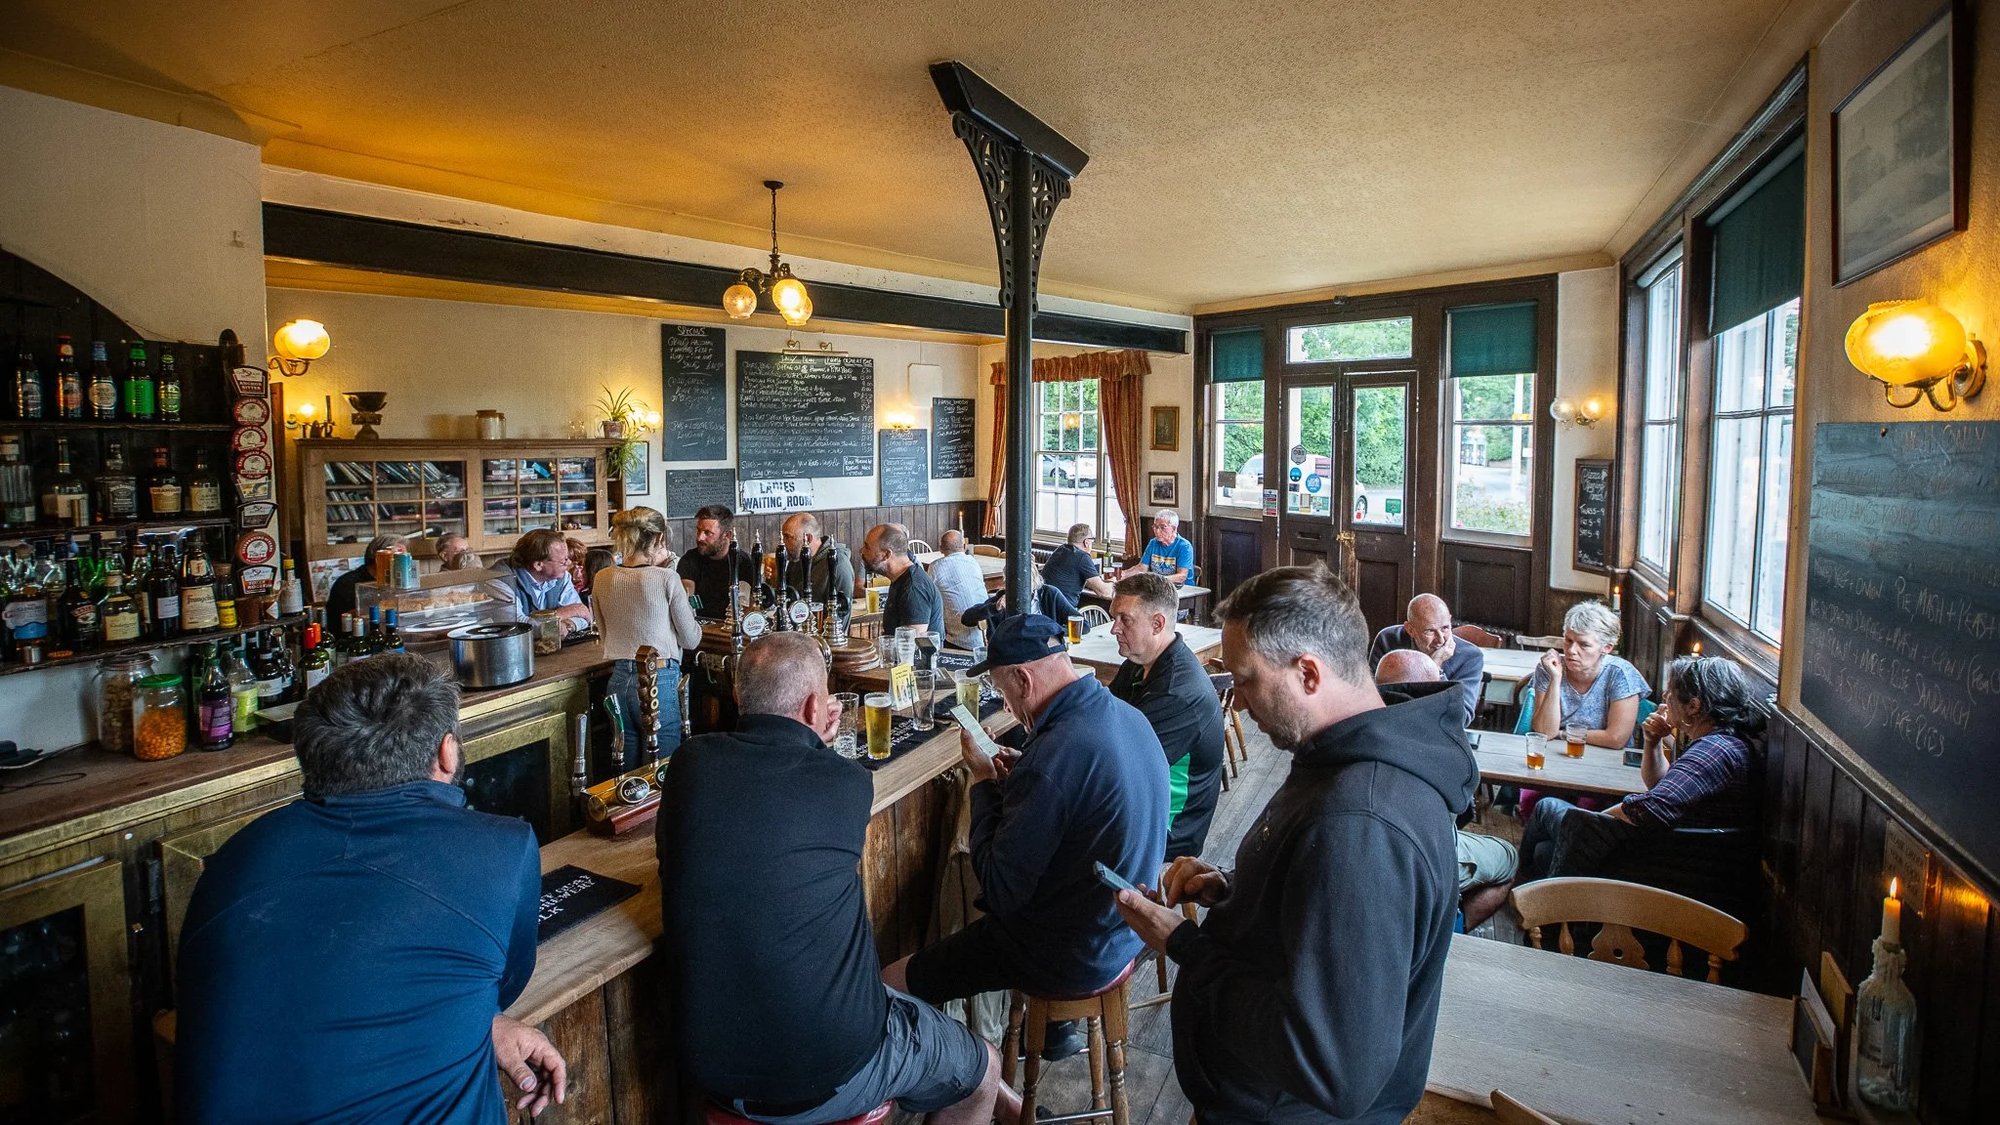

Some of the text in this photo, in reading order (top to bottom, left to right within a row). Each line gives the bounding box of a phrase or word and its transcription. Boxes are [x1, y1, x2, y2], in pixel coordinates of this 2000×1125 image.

[744, 495, 812, 509] WAITING ROOM
[1916, 586, 1945, 625] MASH
[624, 782, 649, 798] GUINNESS
